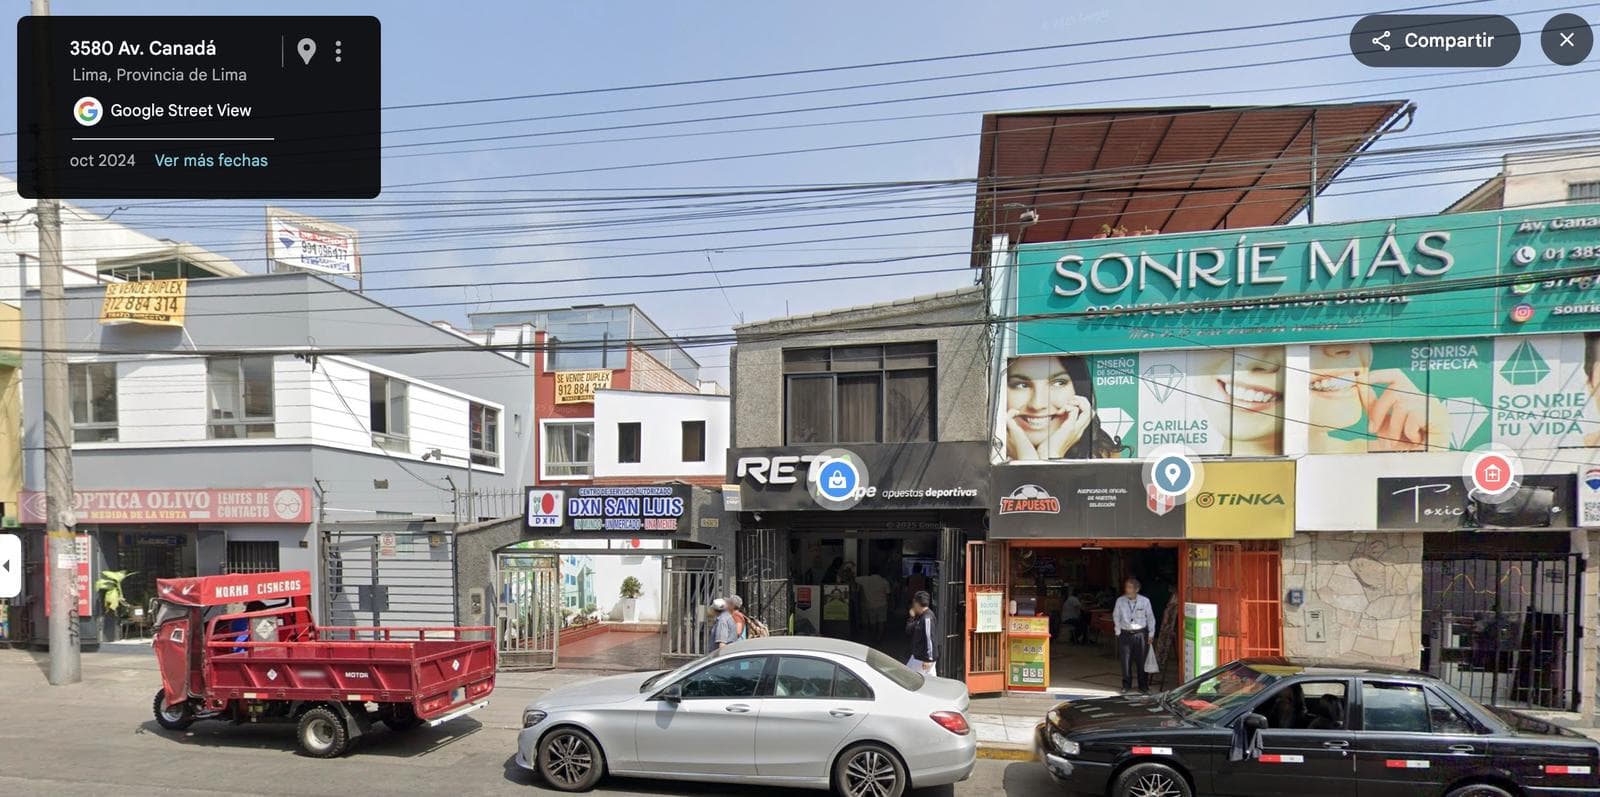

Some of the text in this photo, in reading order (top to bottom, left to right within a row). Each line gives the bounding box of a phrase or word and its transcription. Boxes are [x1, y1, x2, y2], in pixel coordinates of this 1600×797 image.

[1518, 216, 1600, 232] Av. Cana
[1054, 222, 1455, 297] SONRÍE MÁS
[1544, 247, 1566, 260] 01
[119, 282, 147, 295] VENDE
[148, 280, 182, 294] DUPLEX
[125, 296, 150, 311] 884
[154, 296, 178, 312] 314
[1410, 344, 1478, 359] SONRISA
[1096, 357, 1135, 369] DISEÑO
[1410, 357, 1478, 372] PERFECTA
[557, 372, 610, 383] SE VENDE DUPLEX
[1096, 376, 1135, 386] DIGITAL
[558, 384, 572, 395] 912
[574, 383, 589, 394] 884
[1498, 392, 1585, 410] SONRIE
[1498, 408, 1585, 421] PARA TODA
[1143, 419, 1209, 433] CARILLAS
[1498, 421, 1584, 436] TU VIDA
[1143, 432, 1208, 446] DENTALES
[217, 492, 269, 504] LENTES DE
[579, 488, 600, 496] CENTRO
[601, 487, 608, 496] DE
[882, 488, 923, 499] apuestas
[925, 487, 978, 499] deportivas
[147, 491, 210, 509] OLIVO
[568, 496, 684, 517] DXN SAN LUIS
[1001, 499, 1058, 512] TE APUESTO
[1391, 483, 1465, 524] Toxic
[90, 510, 187, 519] MEDIDA DE LA VISTA
[217, 505, 270, 518] CONTACTO
[215, 580, 301, 599] NORMA CISNEROS
